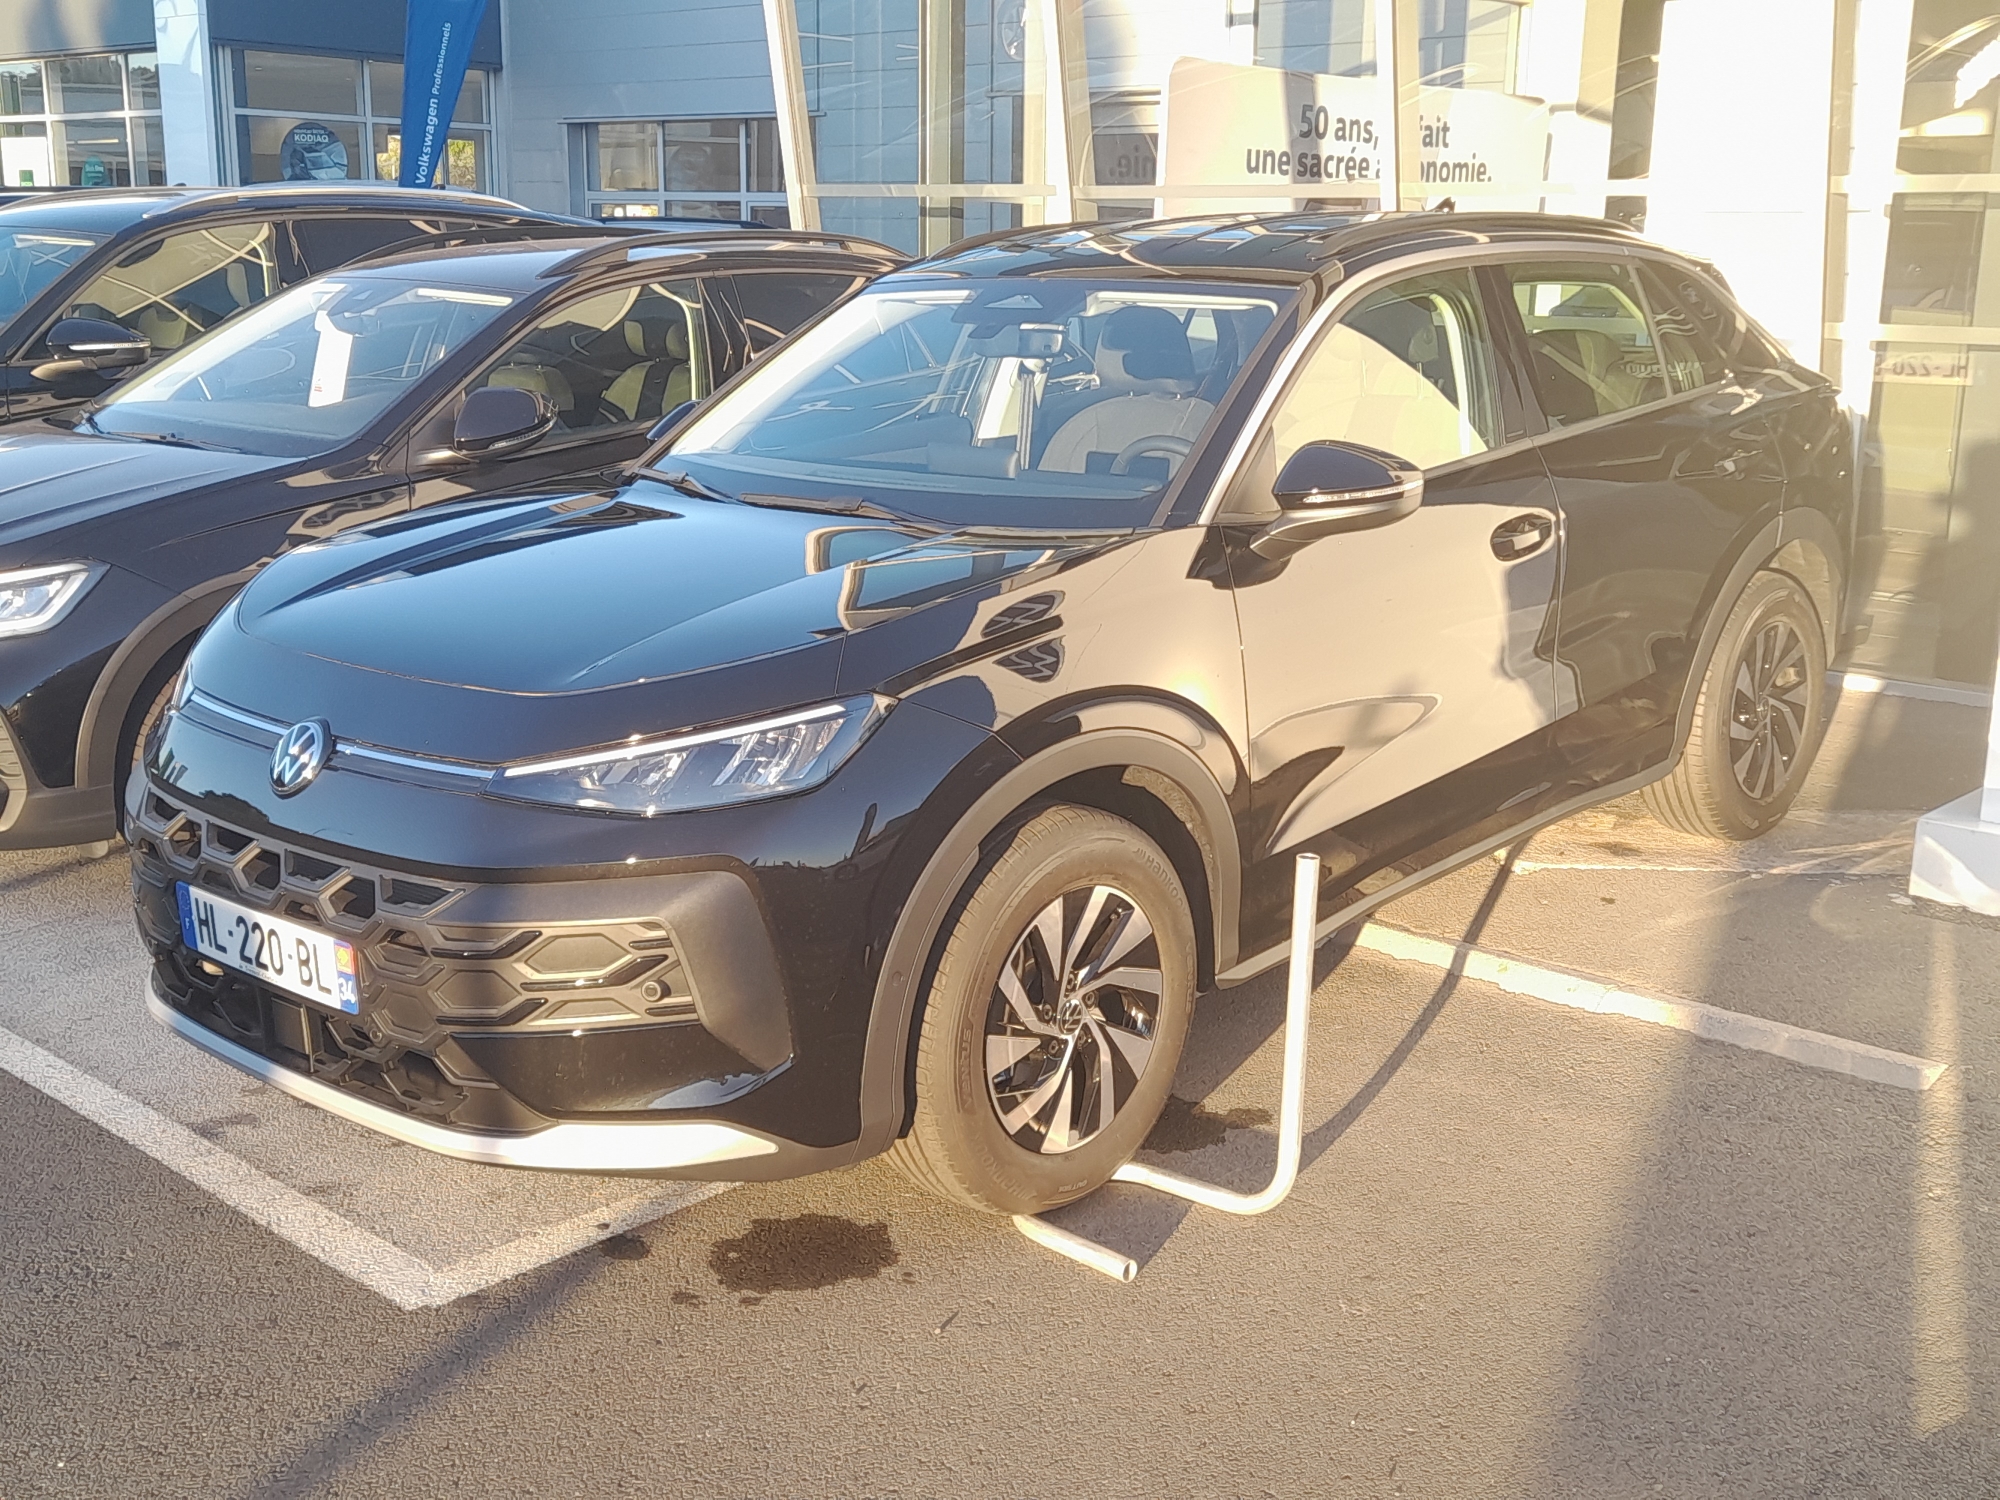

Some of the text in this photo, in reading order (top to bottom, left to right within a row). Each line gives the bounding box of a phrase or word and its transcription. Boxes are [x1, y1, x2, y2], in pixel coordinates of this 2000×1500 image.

[415, 22, 451, 184] Volkswagen Professionnels
[294, 133, 329, 143] KODIAQ
[1299, 104, 1329, 140] 50
[1334, 116, 1379, 151] ans,
[1246, 148, 1291, 176] une
[1296, 147, 1370, 179] sacrée
[194, 897, 332, 995] HL-220-BL
[338, 977, 356, 1004] 34
